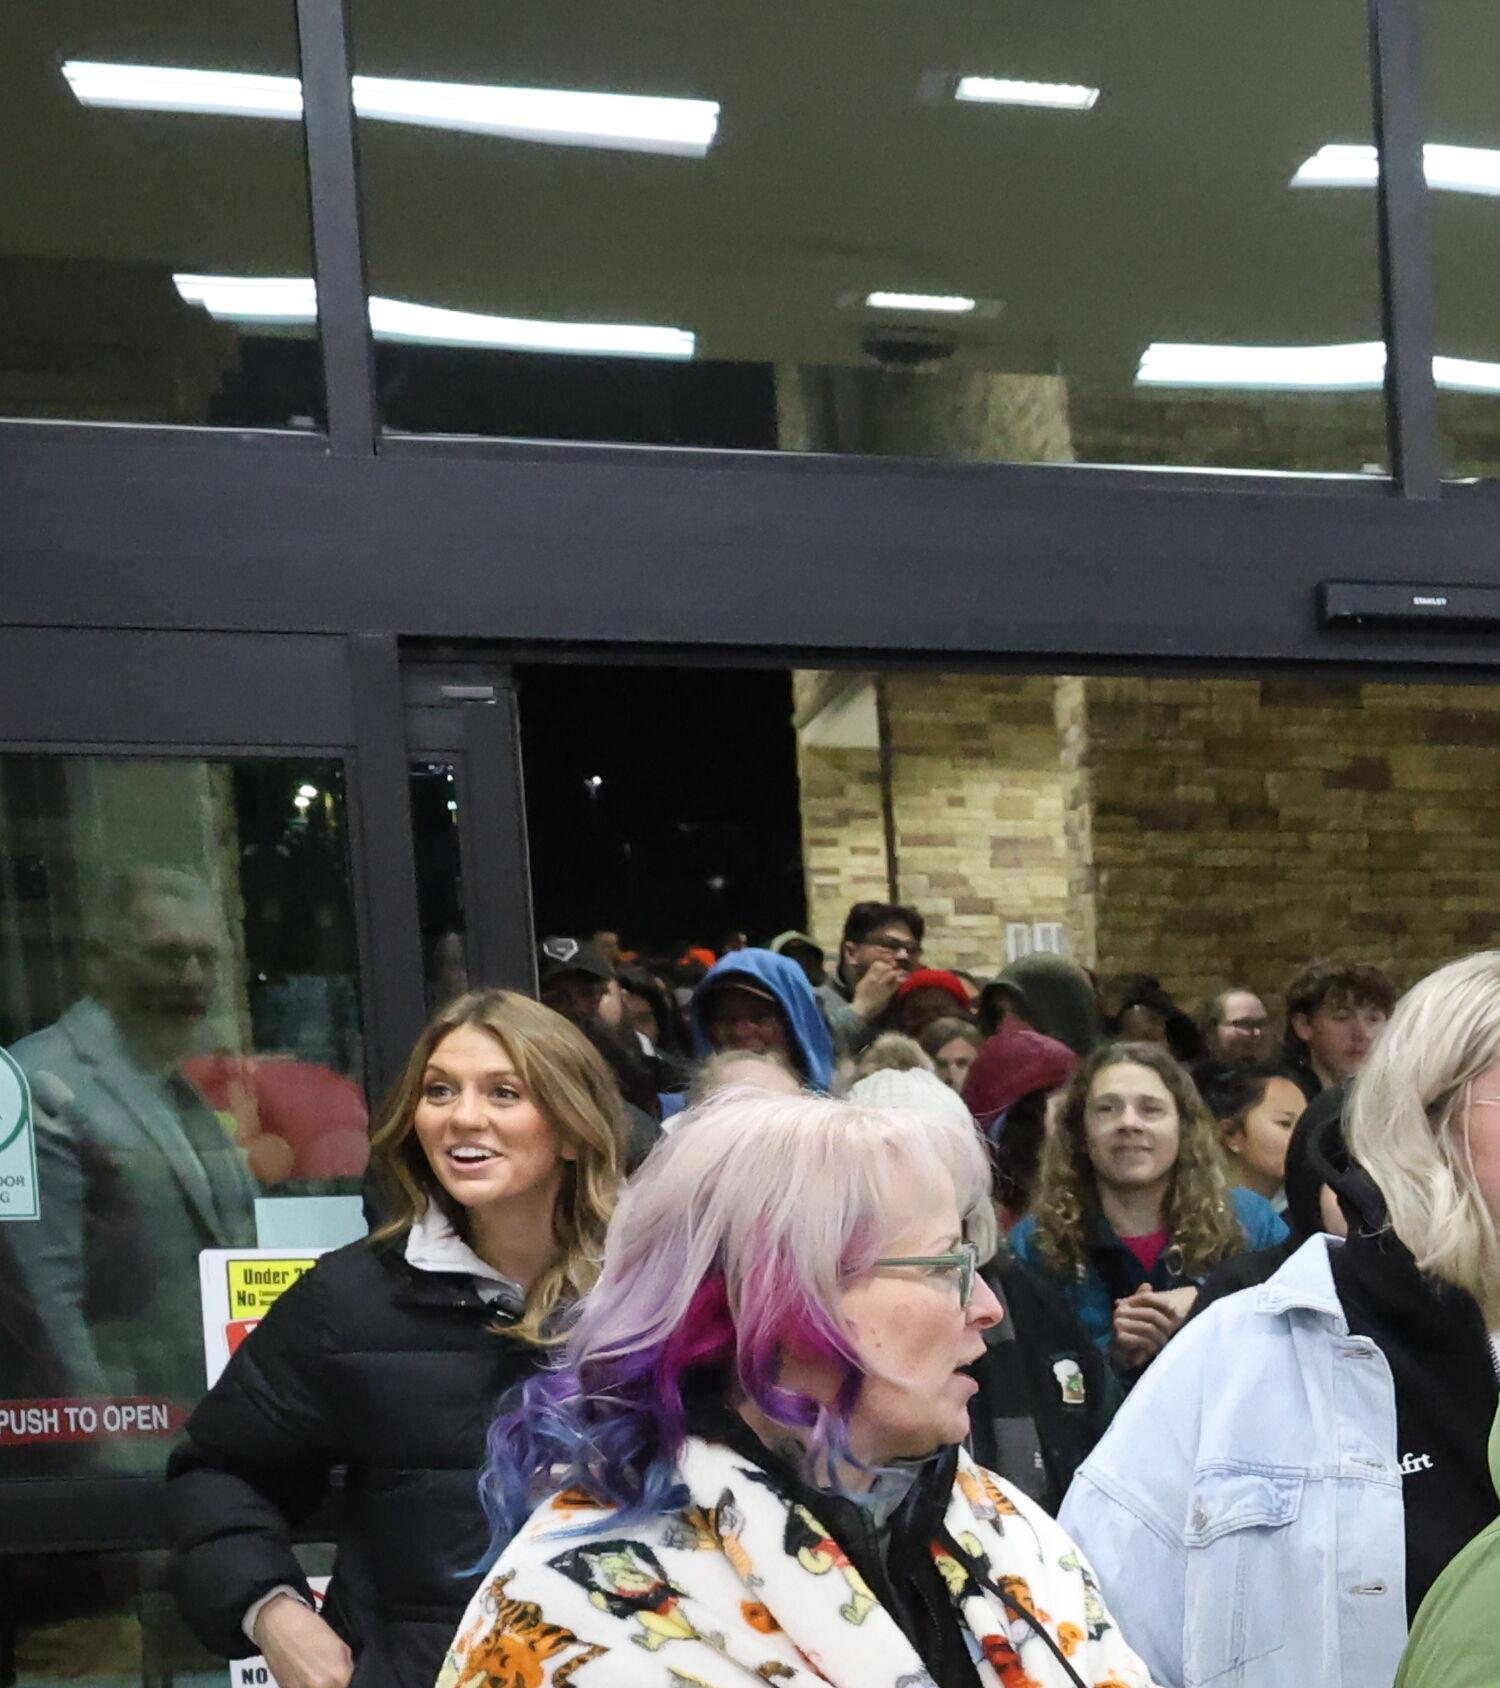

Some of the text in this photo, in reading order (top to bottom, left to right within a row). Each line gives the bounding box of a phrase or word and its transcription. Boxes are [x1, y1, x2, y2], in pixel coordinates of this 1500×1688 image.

[243, 1268, 289, 1285] Under
[236, 1290, 257, 1307] No
[0, 1404, 168, 1435] PUSH TO OPEN
[1400, 1452, 1434, 1475] frt
[241, 1668, 268, 1685] NO
